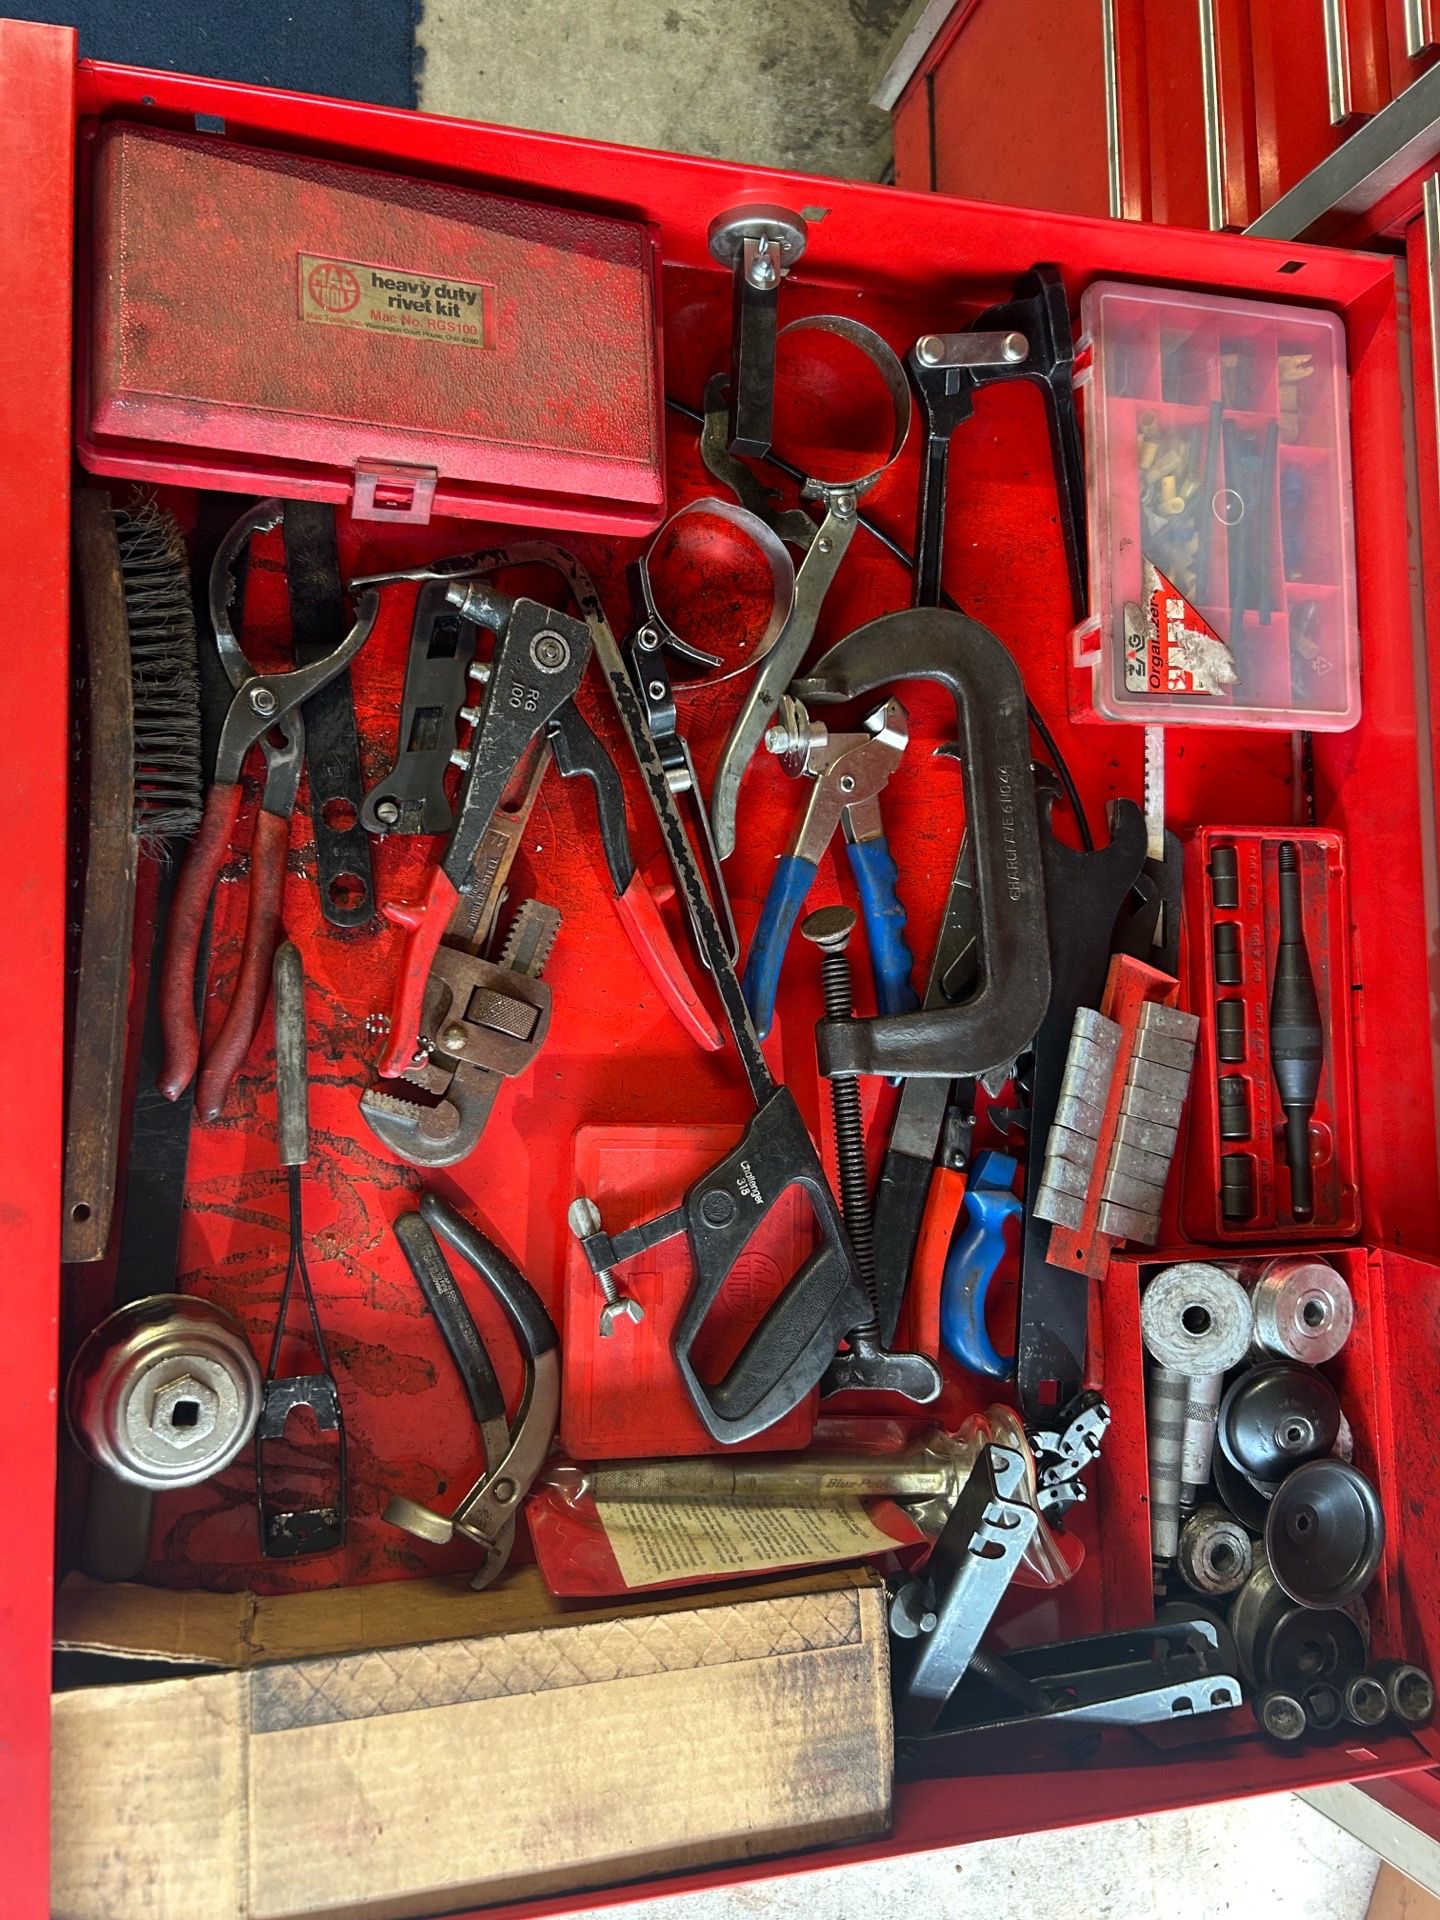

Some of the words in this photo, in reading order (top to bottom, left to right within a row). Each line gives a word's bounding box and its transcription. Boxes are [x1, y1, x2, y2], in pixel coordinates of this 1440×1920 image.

[371, 272, 432, 297] heavy
[434, 284, 477, 305] duty
[388, 294, 432, 314] rivet
[435, 300, 461, 318] kit
[306, 311, 323, 321] Mac
[445, 334, 461, 343] Ohio
[370, 309, 397, 323] Mac
[401, 314, 423, 328] No.
[427, 316, 477, 335] RGS100
[1126, 633, 1146, 677] ZAG
[509, 681, 524, 708] 100
[524, 688, 540, 712] RG
[736, 1177, 751, 1196] 318
[740, 1160, 764, 1204] Challenger
